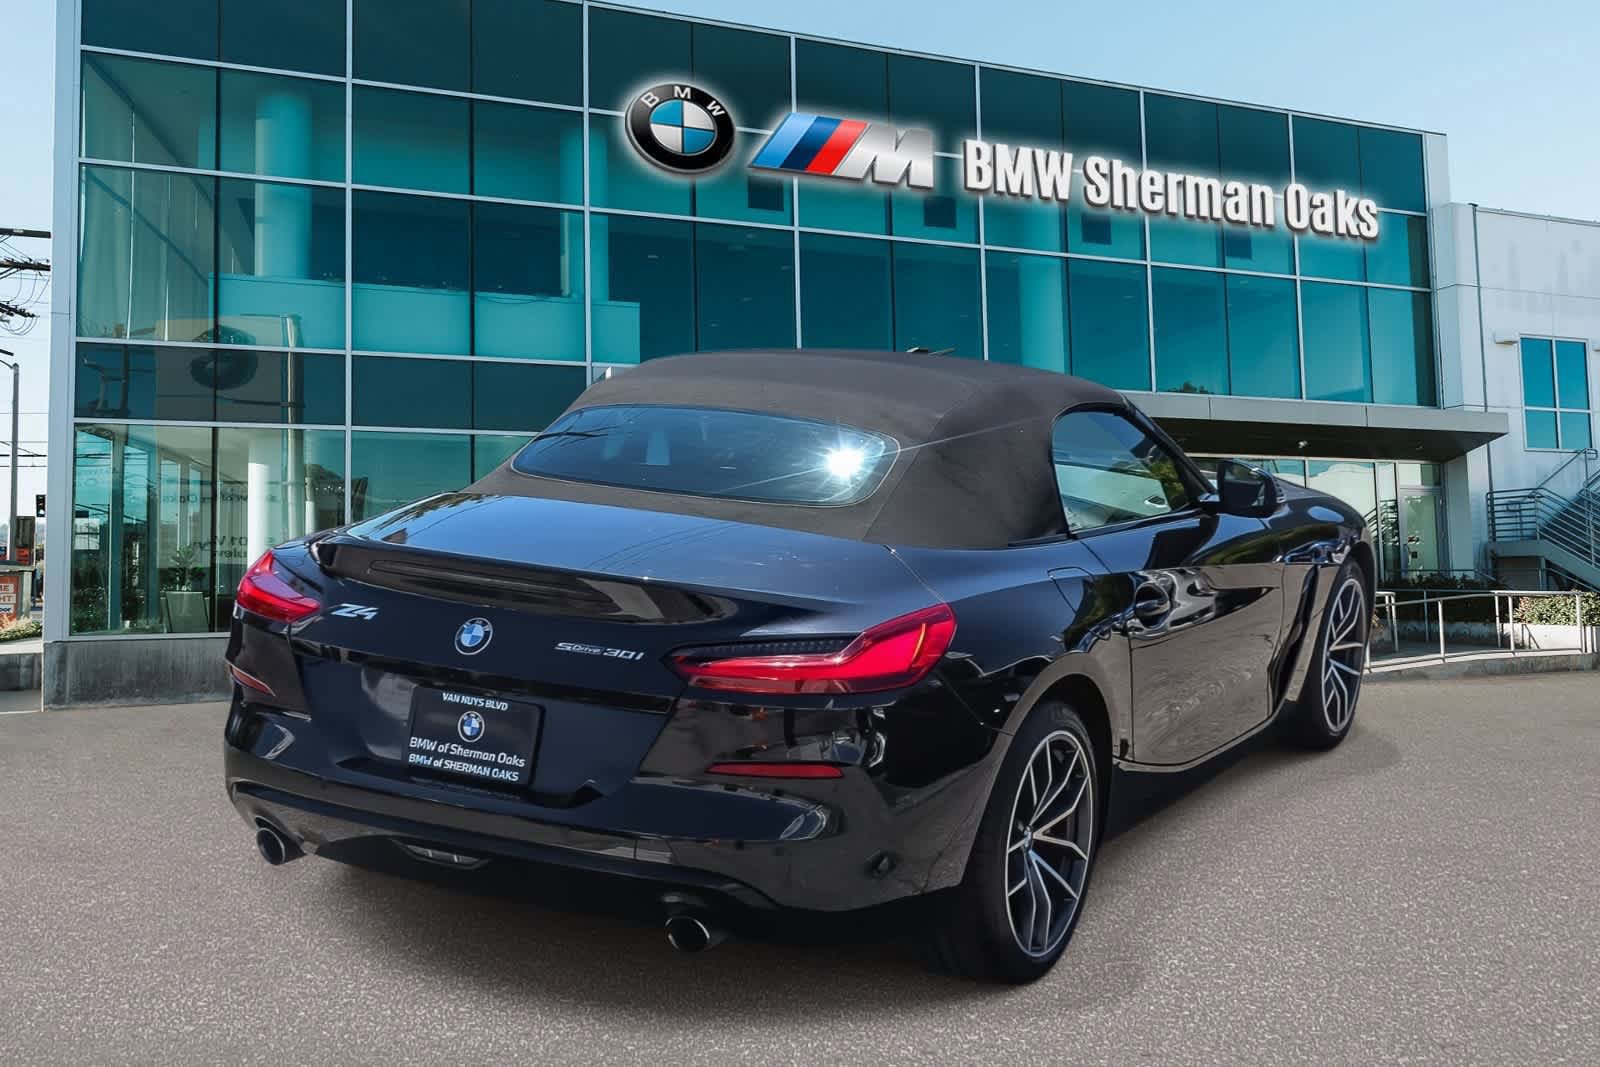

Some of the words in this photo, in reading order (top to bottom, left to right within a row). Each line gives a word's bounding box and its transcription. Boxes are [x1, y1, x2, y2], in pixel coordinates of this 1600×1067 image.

[641, 85, 725, 117] BMW
[964, 139, 1073, 202] BMW
[1083, 156, 1274, 227] Sherman
[1284, 184, 1379, 240] Oaks
[331, 603, 379, 620] Z4
[442, 692, 460, 703] VAN
[460, 695, 485, 707] NUYS
[484, 699, 509, 711] BLVD
[409, 737, 438, 751] BMW
[437, 743, 449, 753] of
[449, 743, 496, 762] Sherman
[497, 752, 526, 767] Oaks
[408, 753, 433, 766] BMW
[433, 758, 444, 768] of
[443, 759, 491, 777] SHERMAN
[491, 768, 520, 782] OAKS
